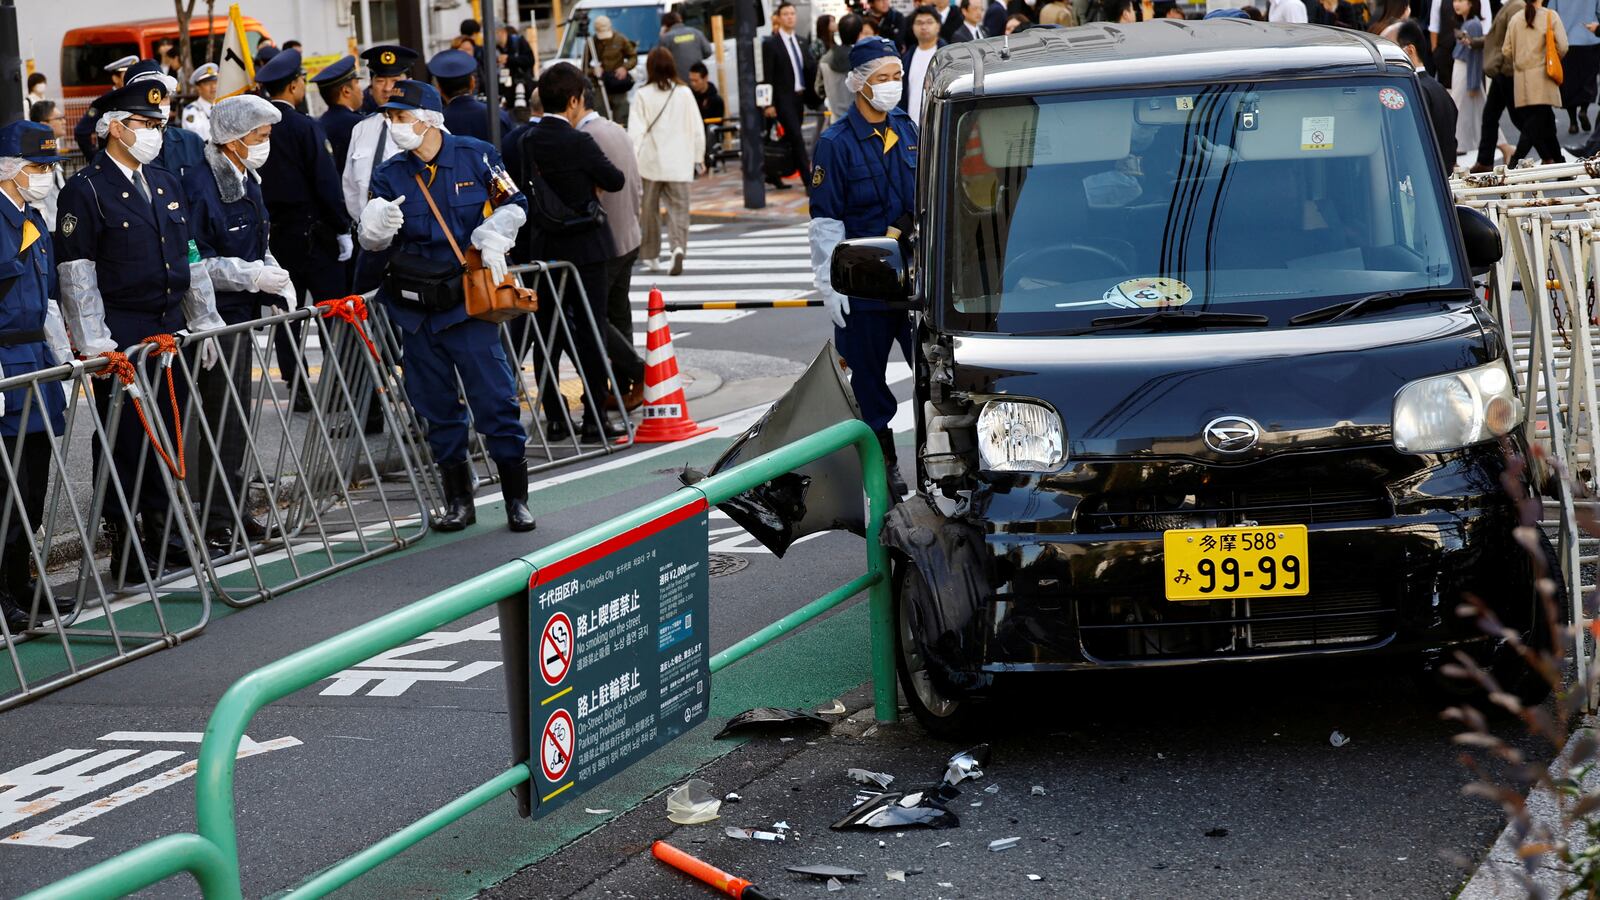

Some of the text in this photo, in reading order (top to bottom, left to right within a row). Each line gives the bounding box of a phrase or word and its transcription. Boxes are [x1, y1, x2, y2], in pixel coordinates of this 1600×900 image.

[1200, 532, 1277, 552] 多摩 588
[585, 574, 605, 589] Chiyoda
[605, 570, 615, 580] City
[1174, 555, 1300, 593] み 99-99
[538, 579, 579, 610] 千代田区内
[576, 589, 640, 639] 路上喫煙禁止
[576, 613, 641, 655] No smoking on the street
[577, 666, 640, 720] 路上駐輪禁止
[577, 713, 604, 735] On-Street
[604, 702, 623, 721] Bicycle
[623, 698, 628, 710] &
[628, 689, 648, 708] Scooter
[578, 713, 626, 751] Parking Prohibited
